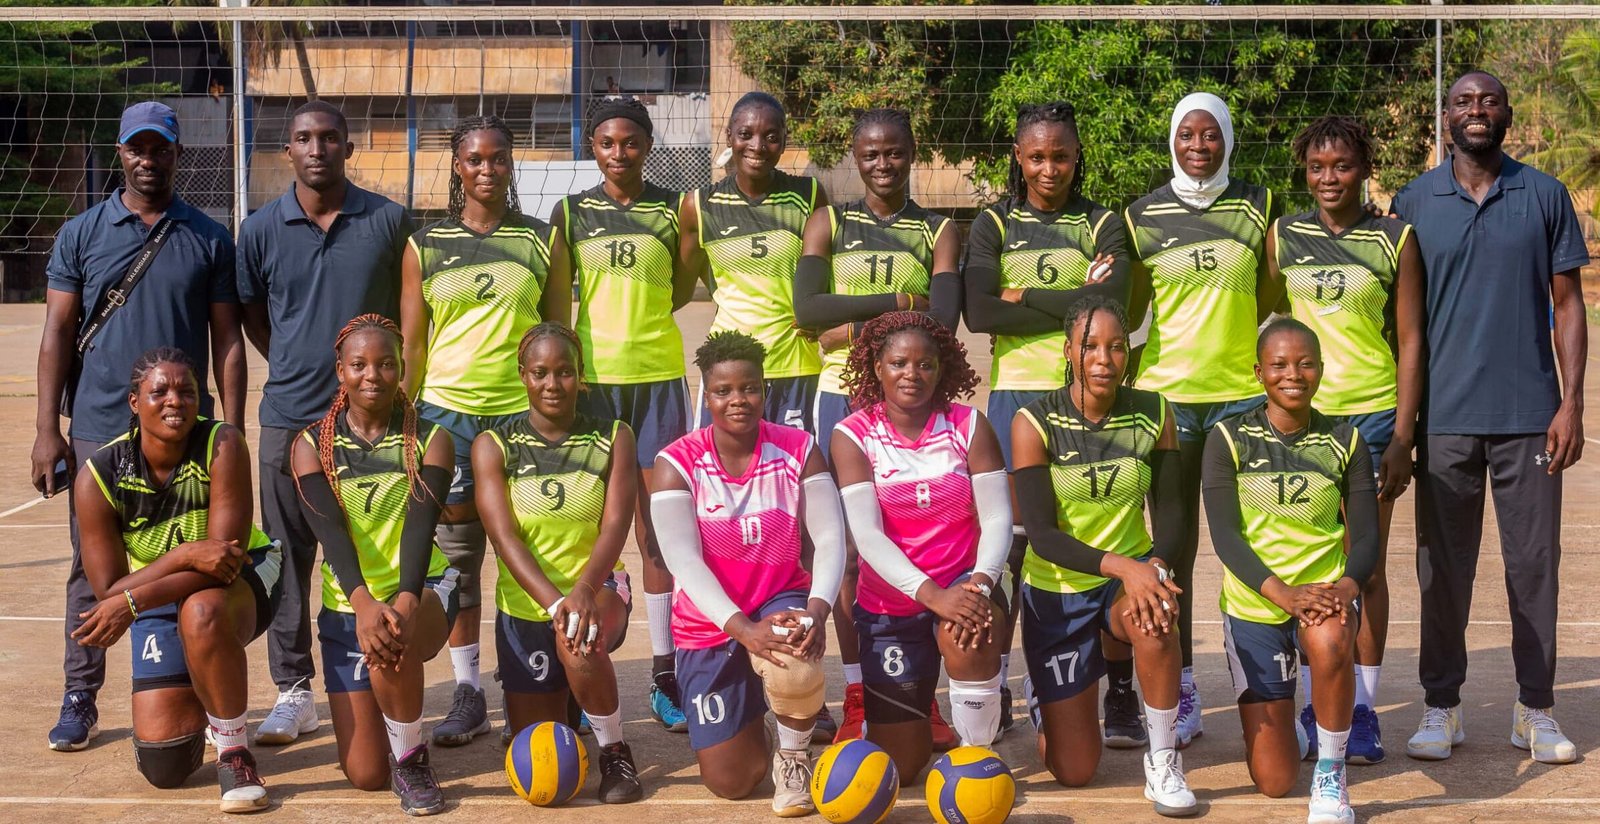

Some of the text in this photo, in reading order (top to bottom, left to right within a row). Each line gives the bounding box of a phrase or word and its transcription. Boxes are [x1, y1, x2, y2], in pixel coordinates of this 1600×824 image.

[605, 240, 637, 269] 18
[751, 236, 769, 259] 5
[1189, 248, 1218, 272] 15
[864, 254, 894, 286] 11
[1036, 253, 1058, 284] 6
[474, 272, 496, 301] 2
[1311, 269, 1346, 301] 19
[784, 409, 804, 431] 5
[540, 478, 565, 511] 9
[915, 483, 931, 508] 8
[1081, 464, 1120, 499] 17
[1271, 473, 1311, 505] 12
[357, 482, 380, 513] 7
[740, 516, 762, 546] 10
[142, 634, 163, 664] 4
[883, 645, 905, 677] 8
[347, 651, 367, 681] 7
[528, 650, 550, 682] 9
[1045, 651, 1080, 687] 17
[691, 692, 726, 725] 10
